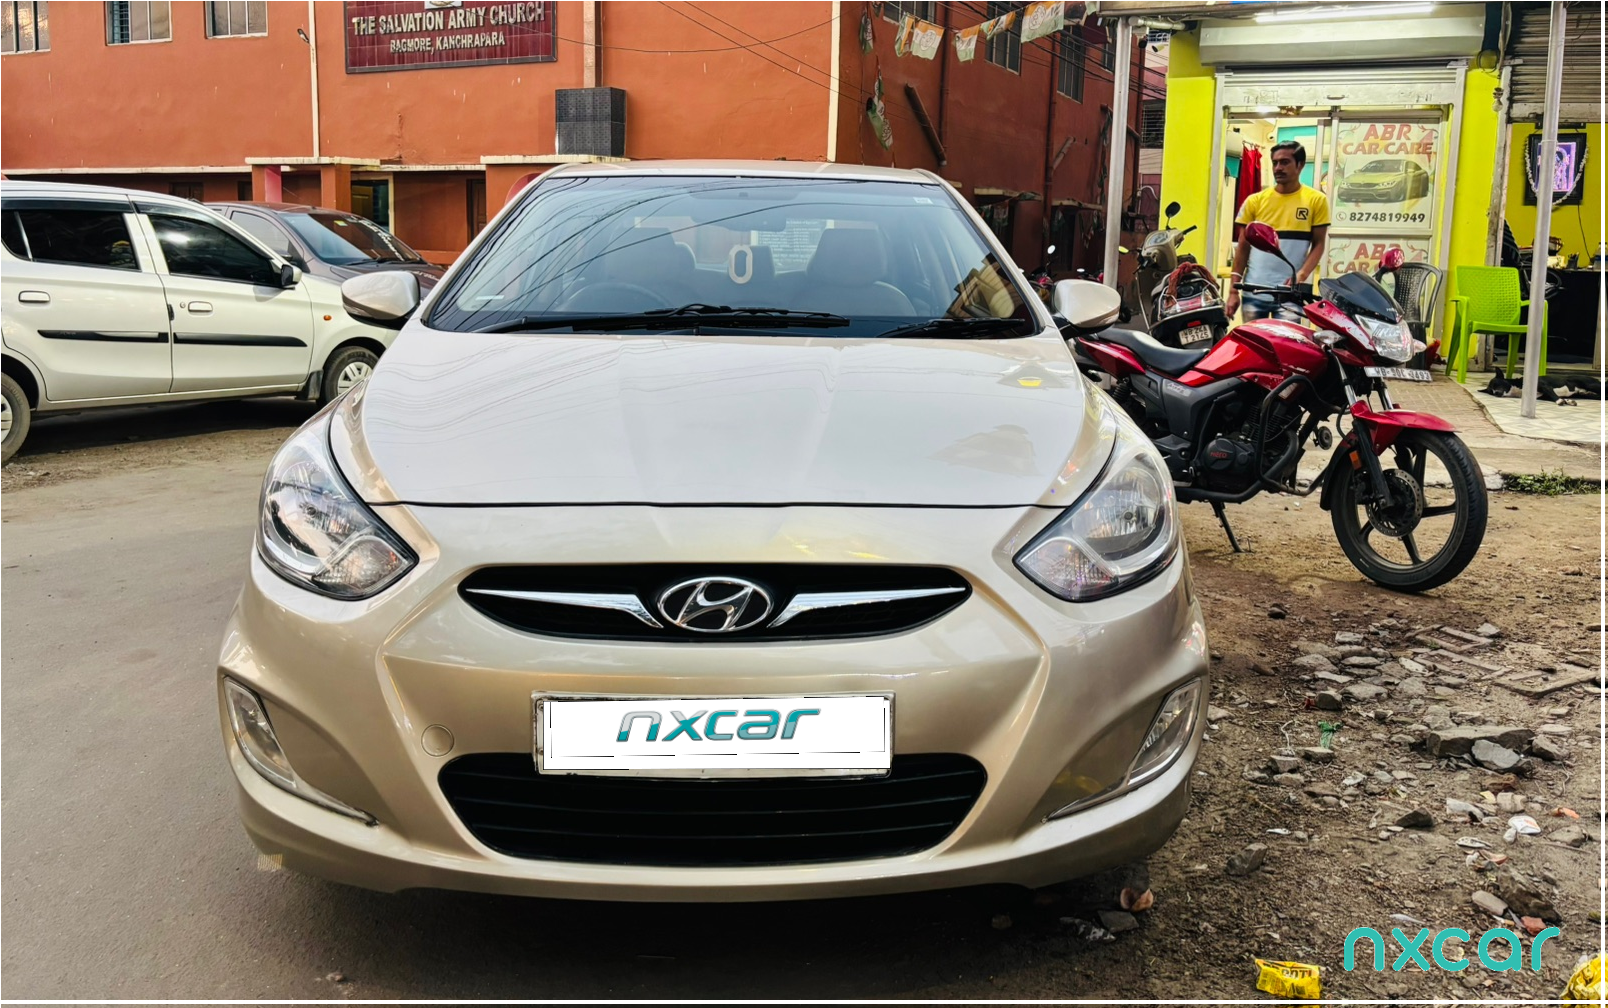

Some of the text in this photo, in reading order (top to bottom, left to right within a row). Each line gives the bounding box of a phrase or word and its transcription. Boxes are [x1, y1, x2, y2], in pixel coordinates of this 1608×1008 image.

[351, 1, 545, 36] THE SALVATION ARMY CHURCH
[390, 31, 505, 55] BAGMORE, KANCHRAPARA
[1363, 124, 1412, 141] ABR
[1342, 142, 1434, 155] CAR CARE
[1349, 212, 1425, 223] 8274819949
[1333, 261, 1370, 275] CAR
